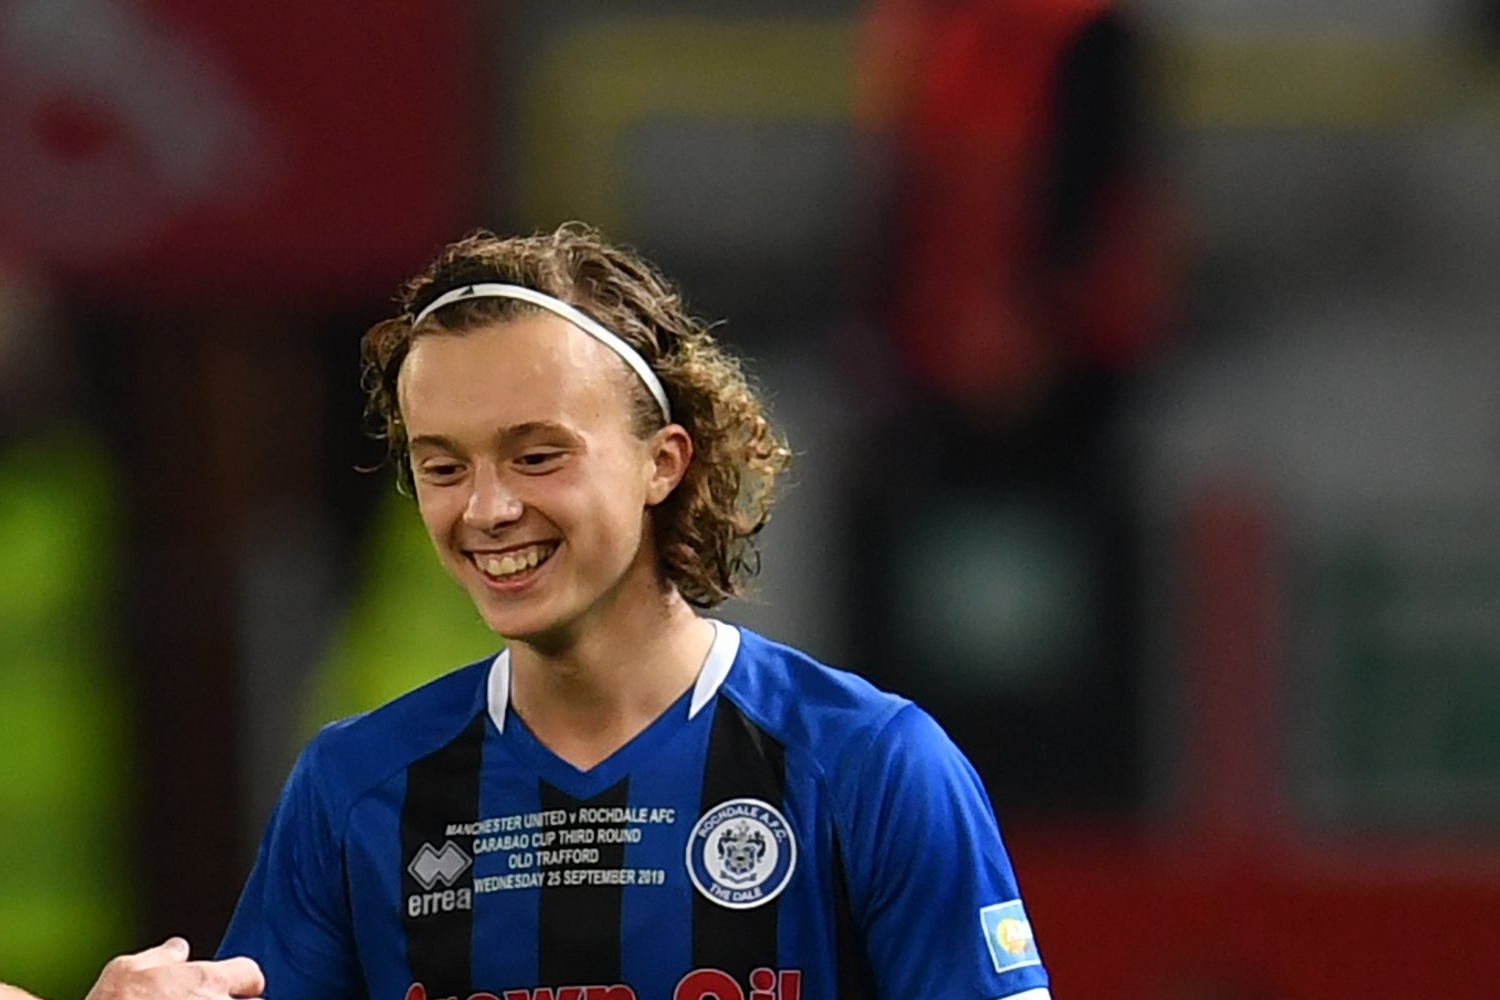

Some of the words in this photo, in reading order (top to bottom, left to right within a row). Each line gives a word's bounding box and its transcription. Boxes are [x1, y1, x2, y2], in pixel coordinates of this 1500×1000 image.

[444, 814, 523, 836] MANCHESTER
[523, 809, 568, 829] UNITED
[578, 807, 649, 824] ROCHDALE
[649, 807, 676, 824] AFC
[472, 833, 530, 855] CARABAO
[531, 830, 557, 848] CUP
[558, 828, 595, 845] THIRD
[597, 827, 642, 843] ROUND
[507, 853, 534, 870] OLD
[535, 848, 600, 867] TRAFFORD
[473, 871, 546, 894] WEDNESDAY
[546, 870, 562, 887] 25
[562, 868, 636, 885] SEPTEMBER
[637, 868, 665, 885] 2019
[732, 886, 763, 902] DALE
[407, 887, 472, 917] errea
